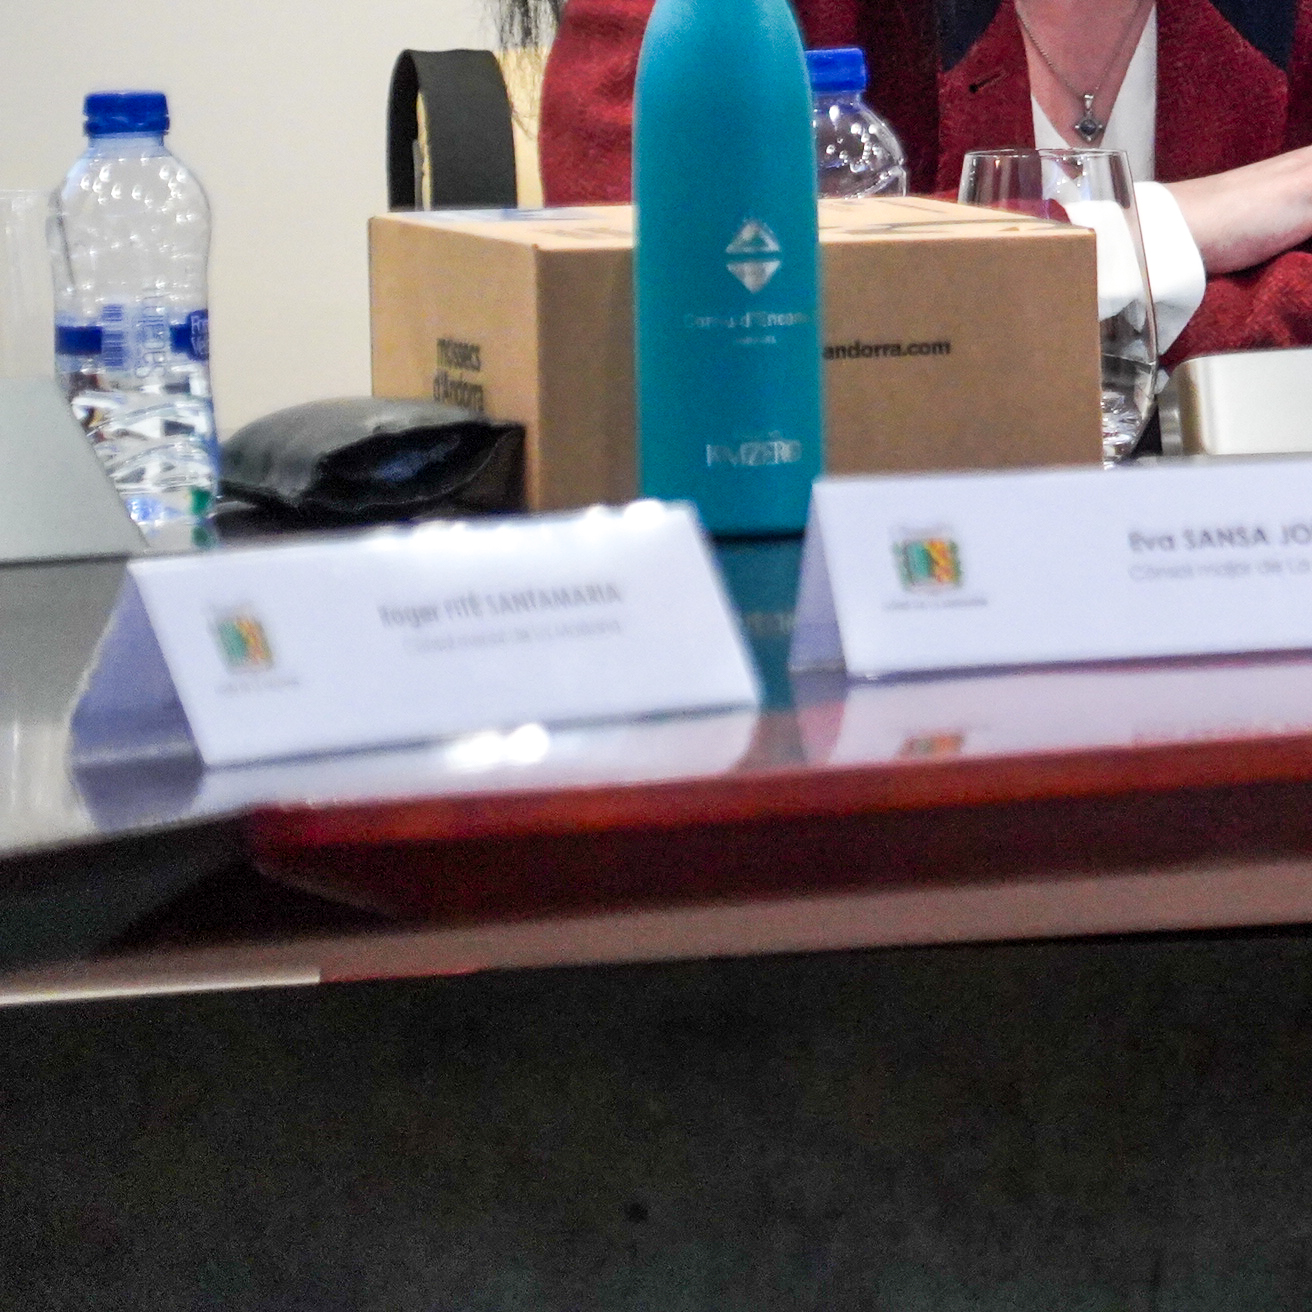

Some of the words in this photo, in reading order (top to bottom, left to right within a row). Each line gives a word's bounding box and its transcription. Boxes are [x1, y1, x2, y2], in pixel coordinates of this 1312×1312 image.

[821, 340, 951, 360] andorra.com
[1128, 530, 1176, 553] Eva
[1182, 526, 1269, 551] SANSA
